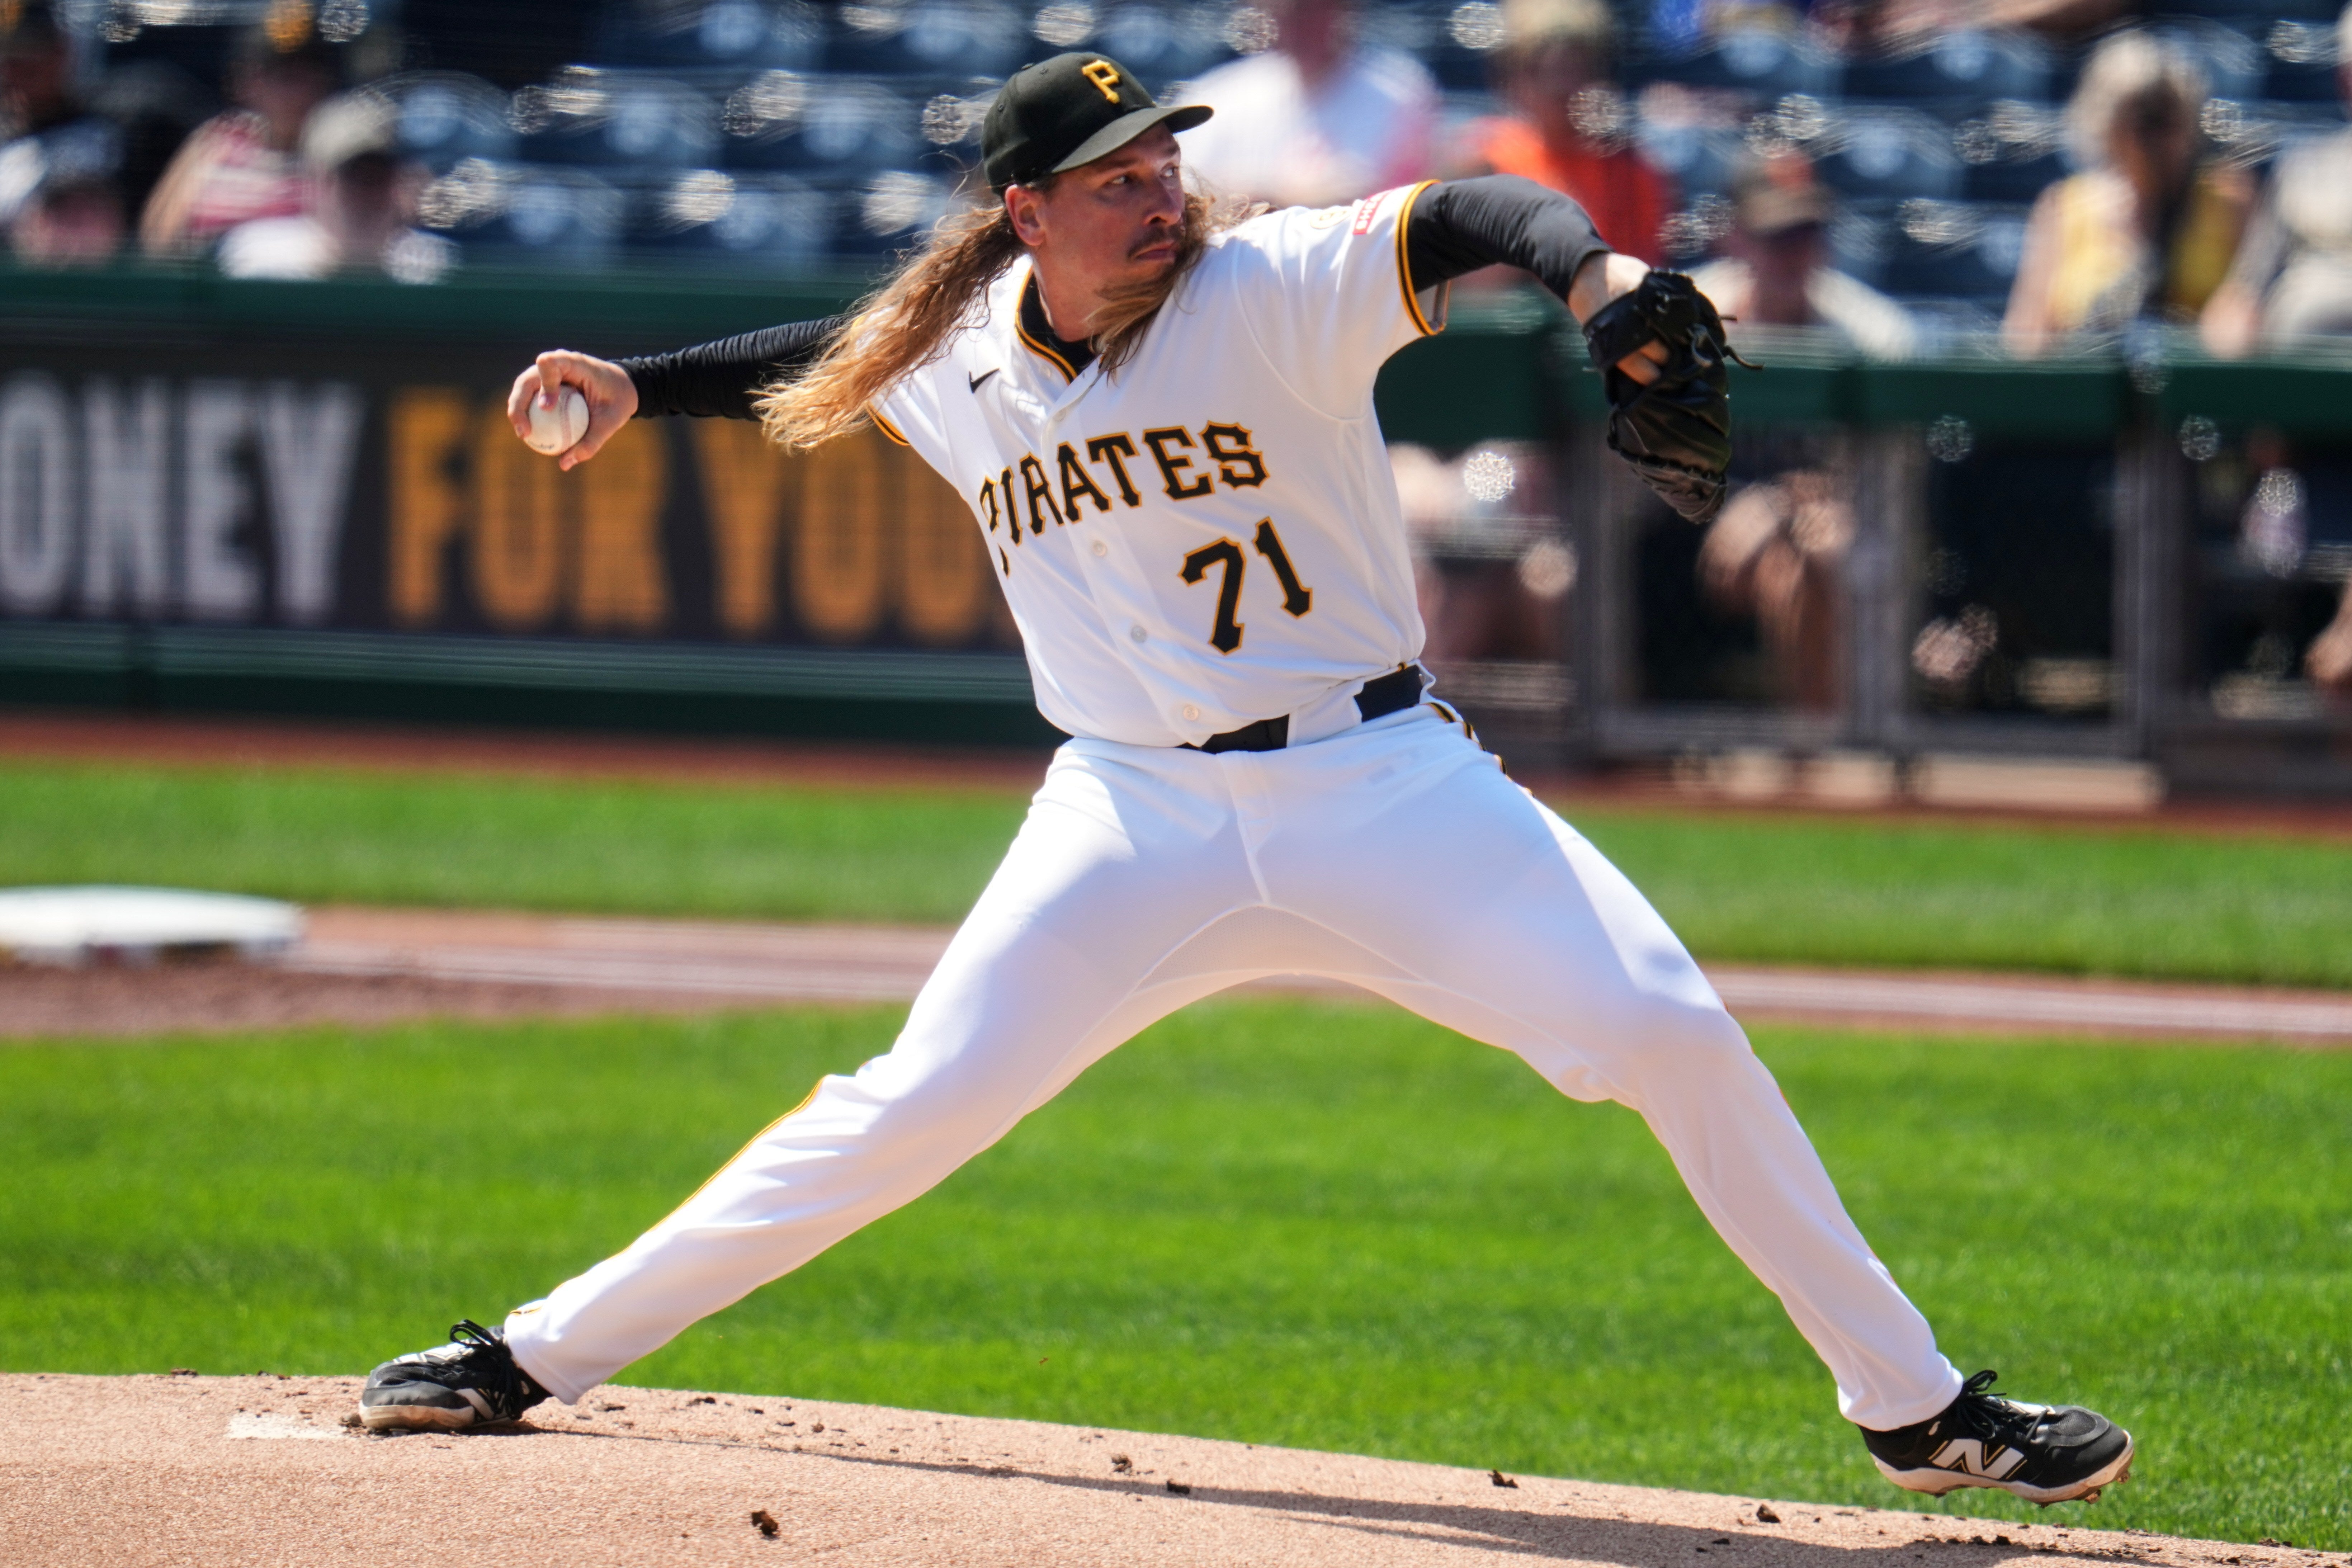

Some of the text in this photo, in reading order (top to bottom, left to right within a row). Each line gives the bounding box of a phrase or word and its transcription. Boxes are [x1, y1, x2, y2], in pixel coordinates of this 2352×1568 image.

[1081, 59, 1120, 104] P
[389, 394, 666, 625] FOR
[696, 416, 1019, 637] YOU
[1177, 516, 1313, 656] 71
